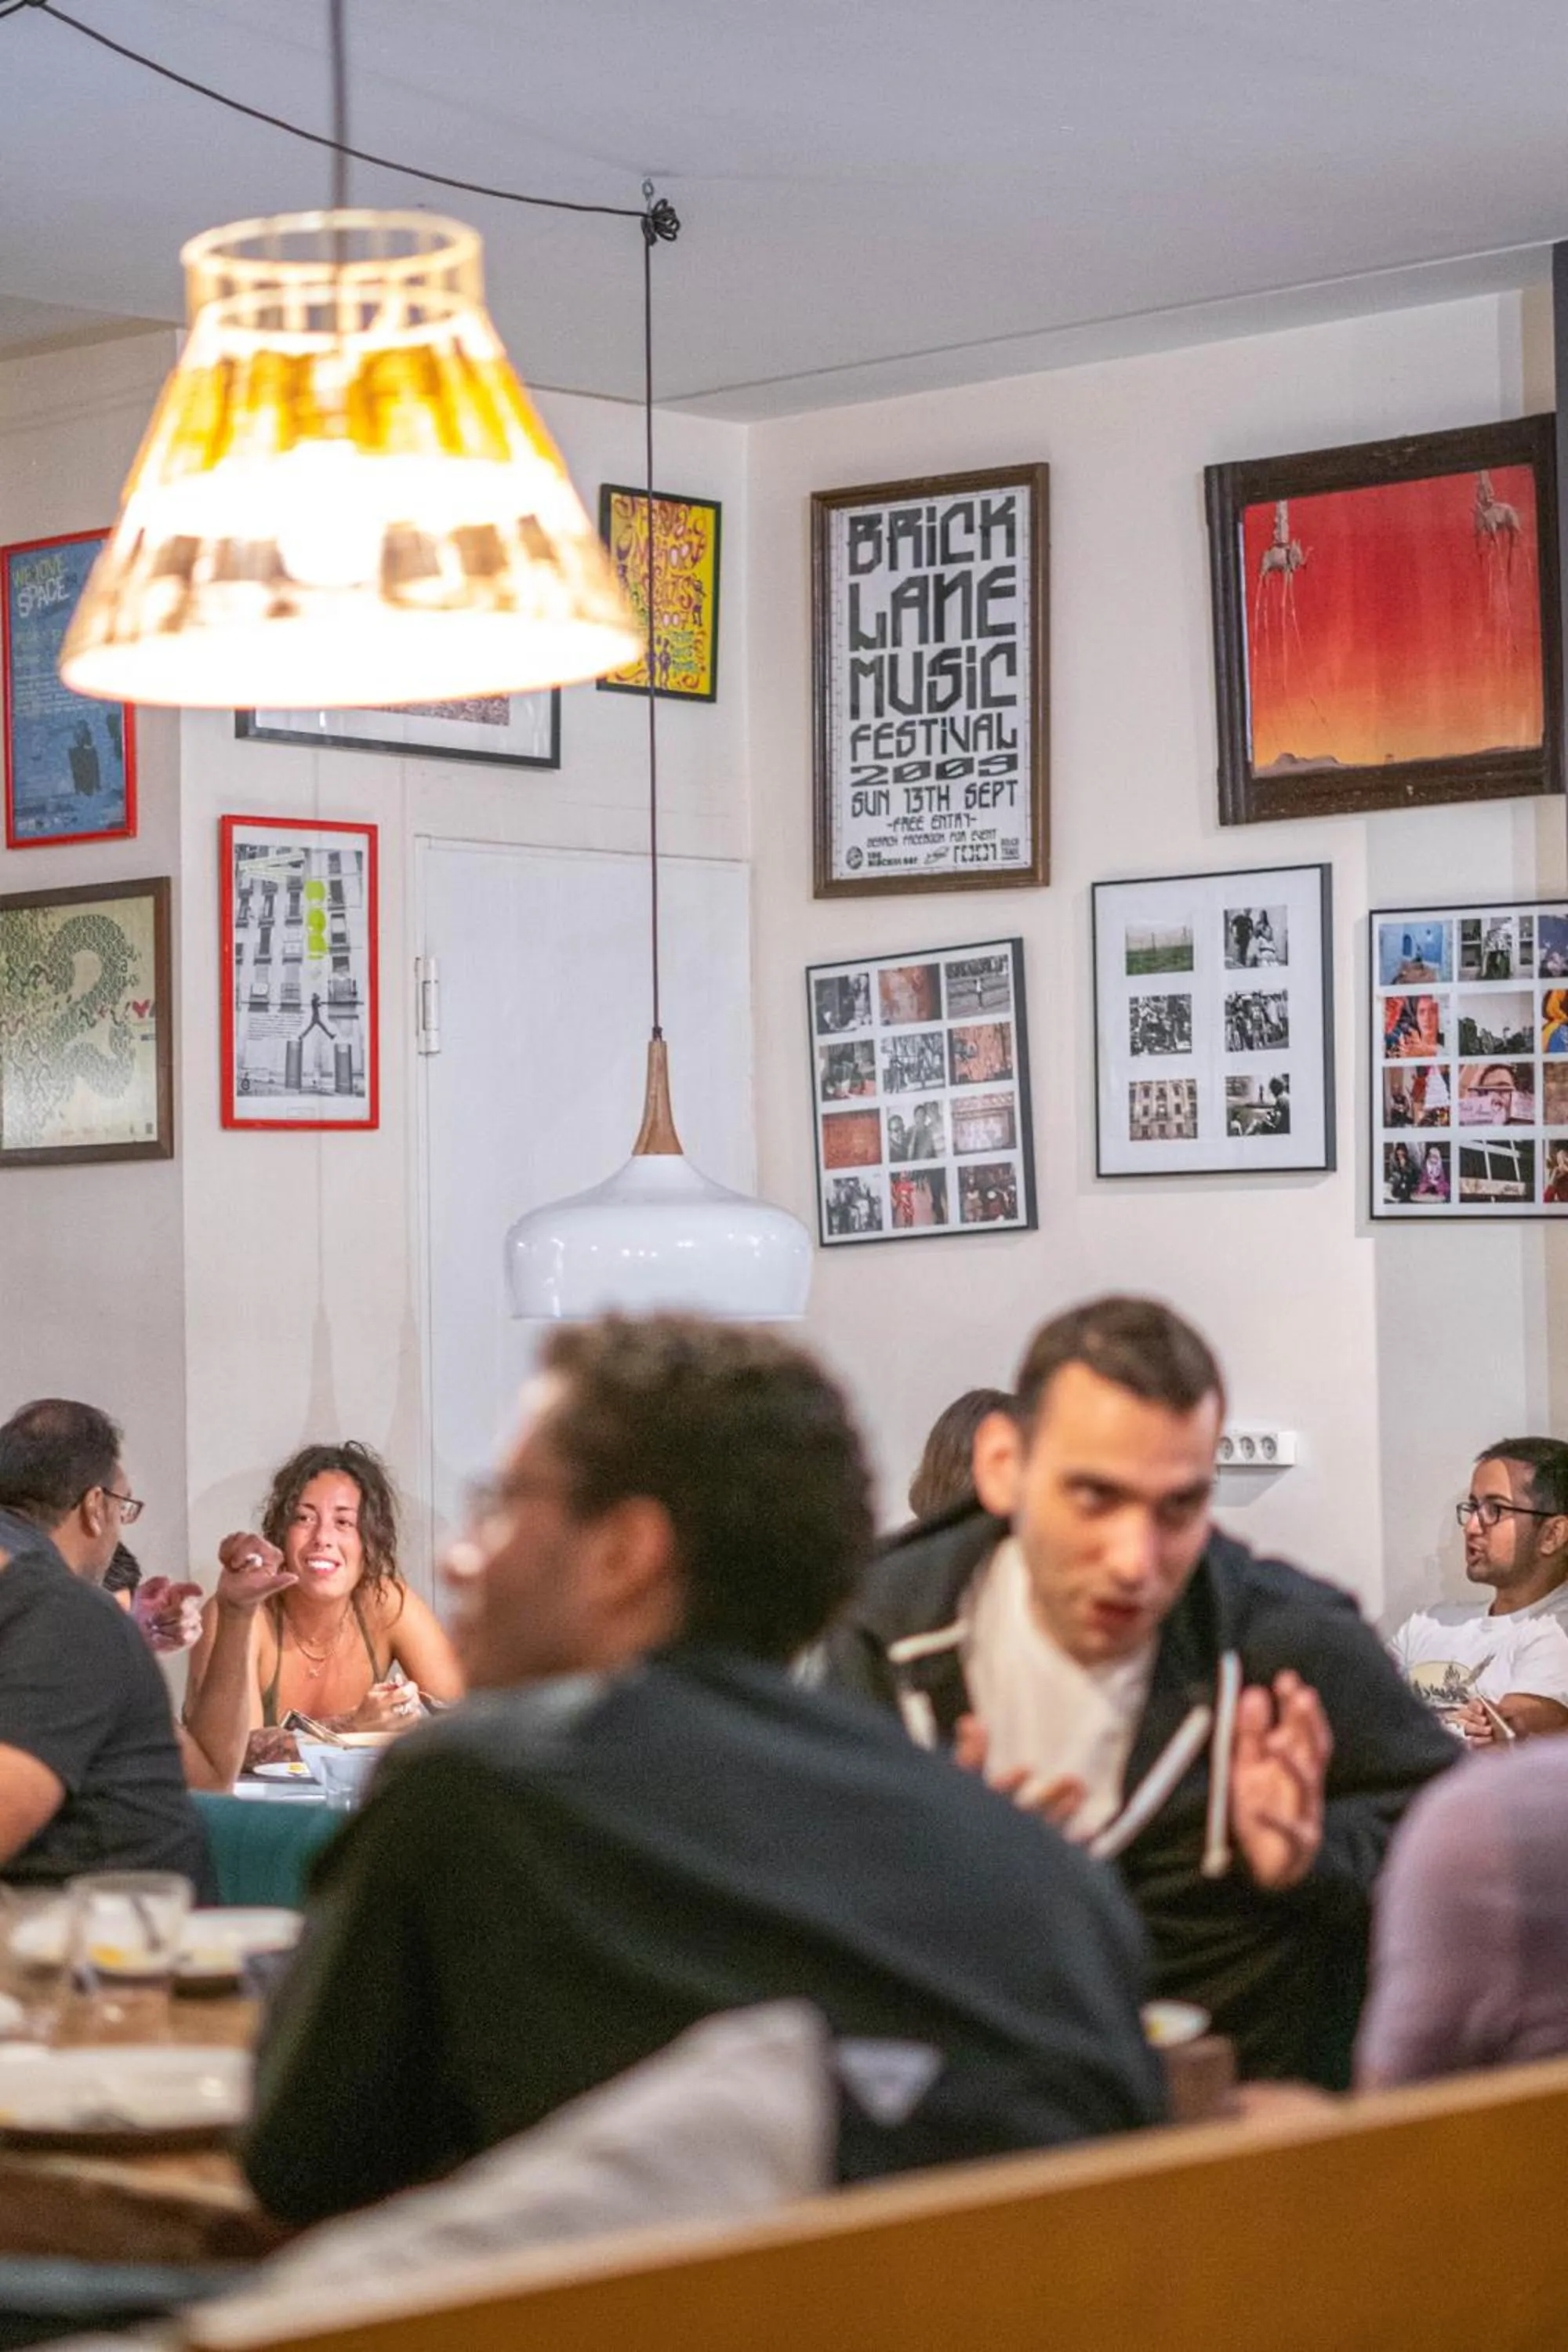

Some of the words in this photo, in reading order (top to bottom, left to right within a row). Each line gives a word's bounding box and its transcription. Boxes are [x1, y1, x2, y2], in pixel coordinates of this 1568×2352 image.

[17, 575, 71, 619] SPACE
[849, 564, 1016, 652] LANE
[850, 753, 1018, 787] 2009
[851, 789, 890, 818] SUN
[904, 785, 950, 814] 13TH
[965, 780, 1018, 810] SEPT
[949, 830, 967, 842] FOR
